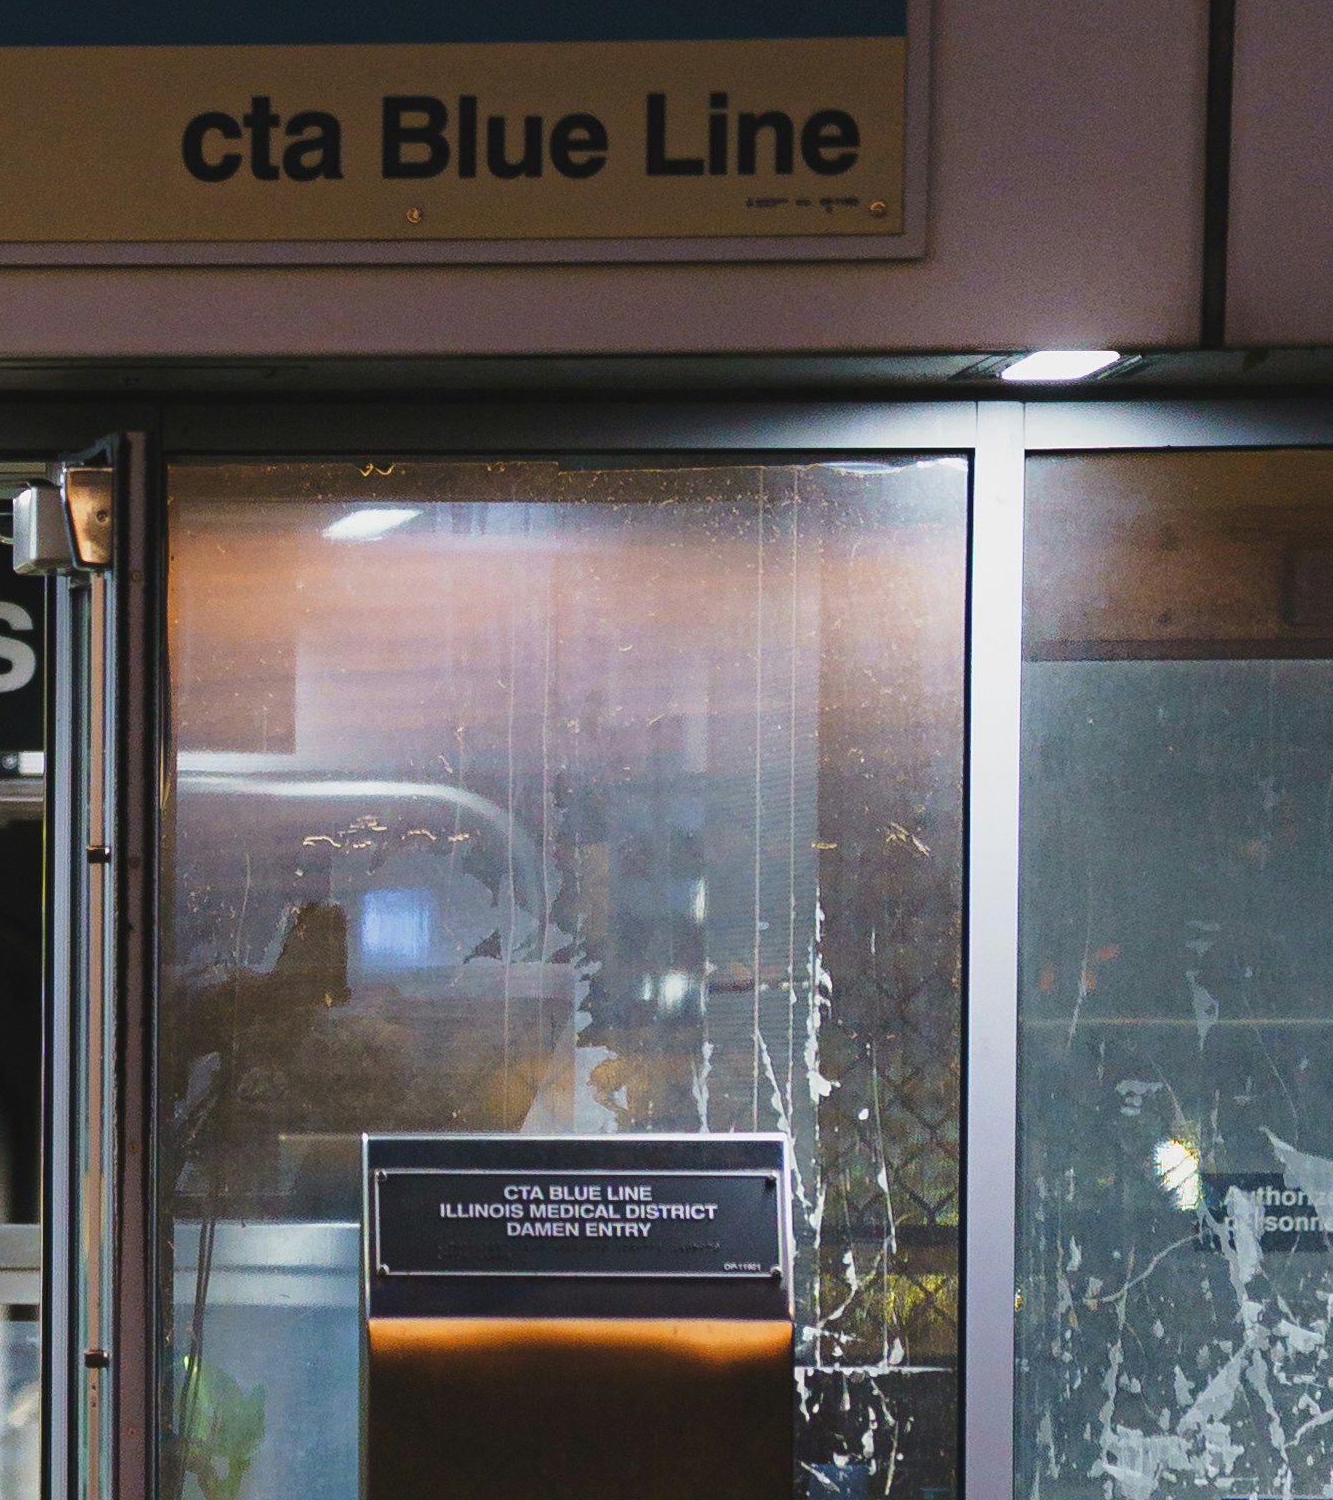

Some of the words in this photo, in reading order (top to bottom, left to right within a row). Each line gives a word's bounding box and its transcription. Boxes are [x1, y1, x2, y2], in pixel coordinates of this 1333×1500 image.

[180, 95, 344, 183] cta
[380, 93, 610, 181] Blue
[644, 90, 862, 177] Line
[503, 1185, 544, 1201] CTA
[549, 1185, 602, 1201] BLUE
[606, 1185, 652, 1201] LINE
[439, 1203, 524, 1218] ILLINOIS
[529, 1203, 621, 1219] MEDICAL
[625, 1203, 718, 1220] DISTRICT
[506, 1221, 580, 1237] DAMEN
[585, 1221, 652, 1237] ENTRY
